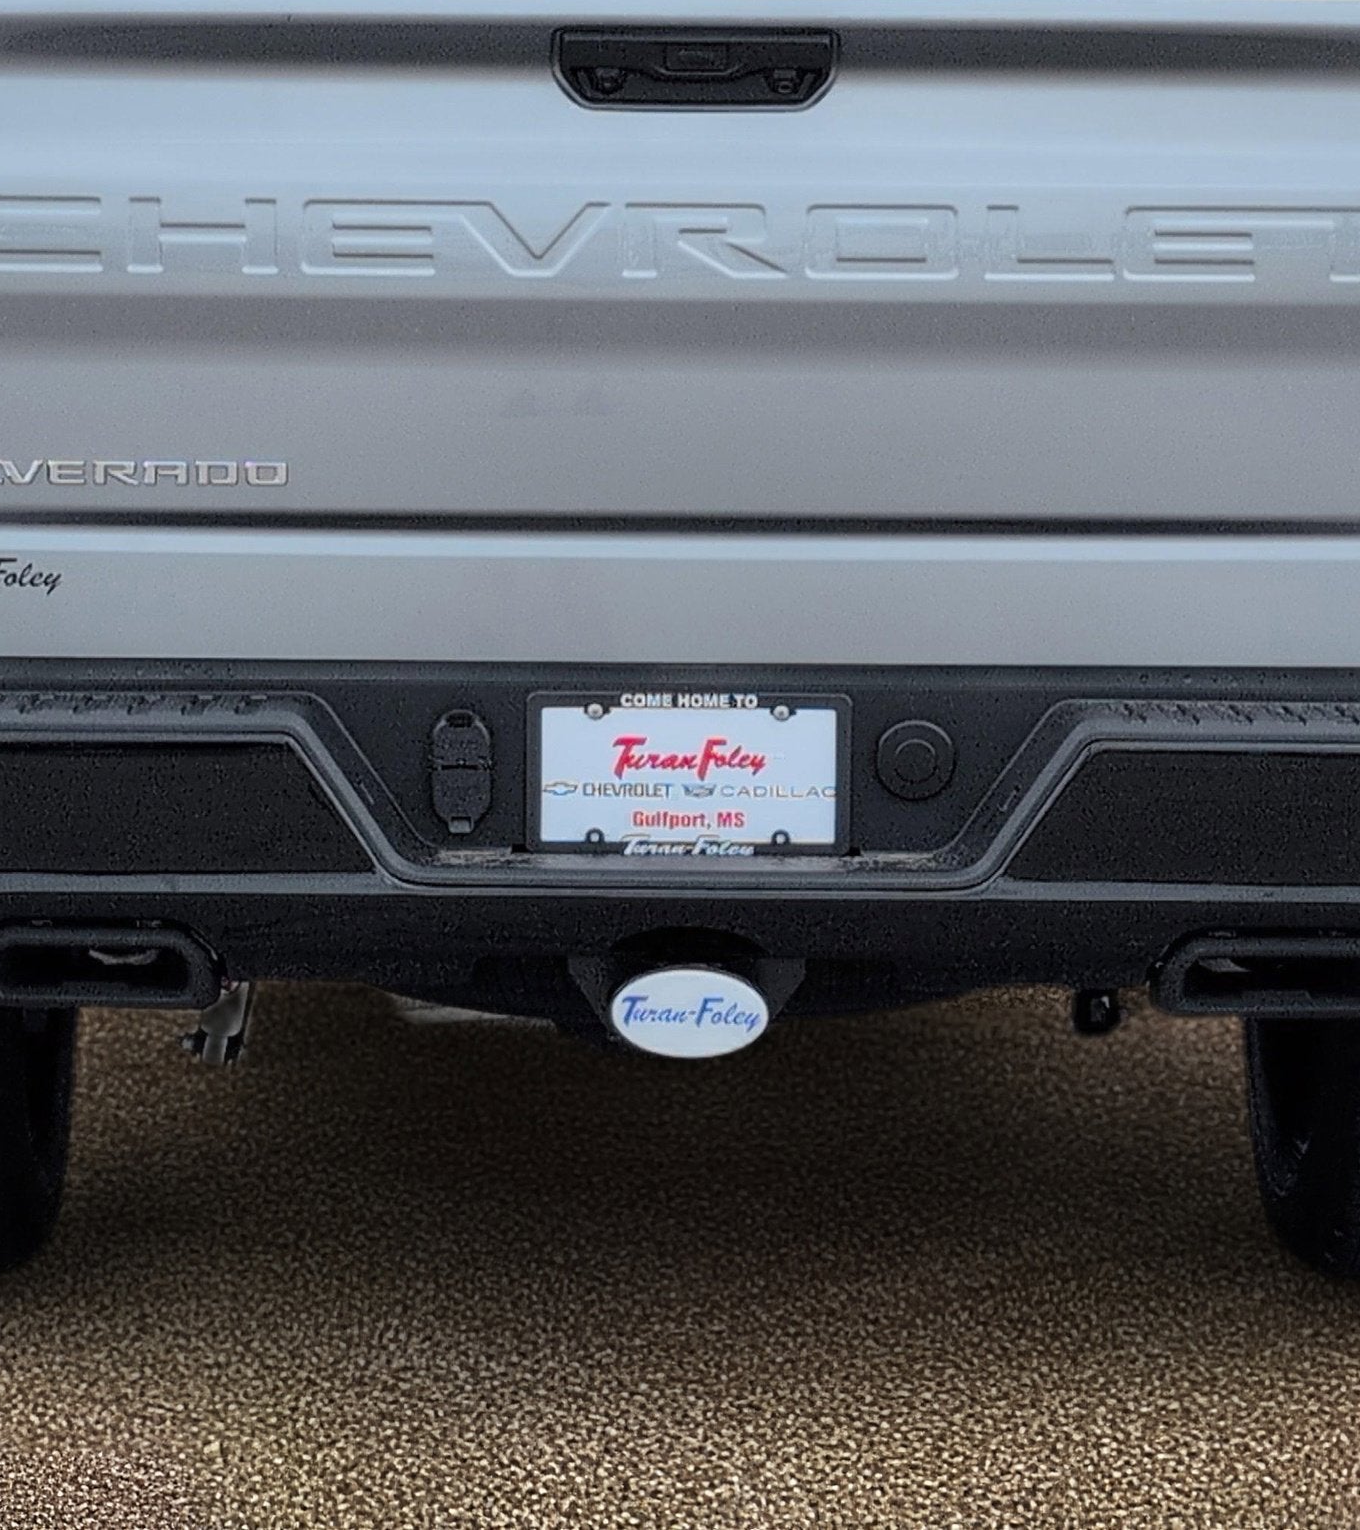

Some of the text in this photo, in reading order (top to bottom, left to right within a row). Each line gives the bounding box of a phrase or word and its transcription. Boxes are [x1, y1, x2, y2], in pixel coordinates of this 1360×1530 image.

[620, 693, 758, 709] COME HOME TO
[582, 782, 837, 799] CHEVROLET CADILLAC
[632, 811, 745, 830] Gulfport, MS
